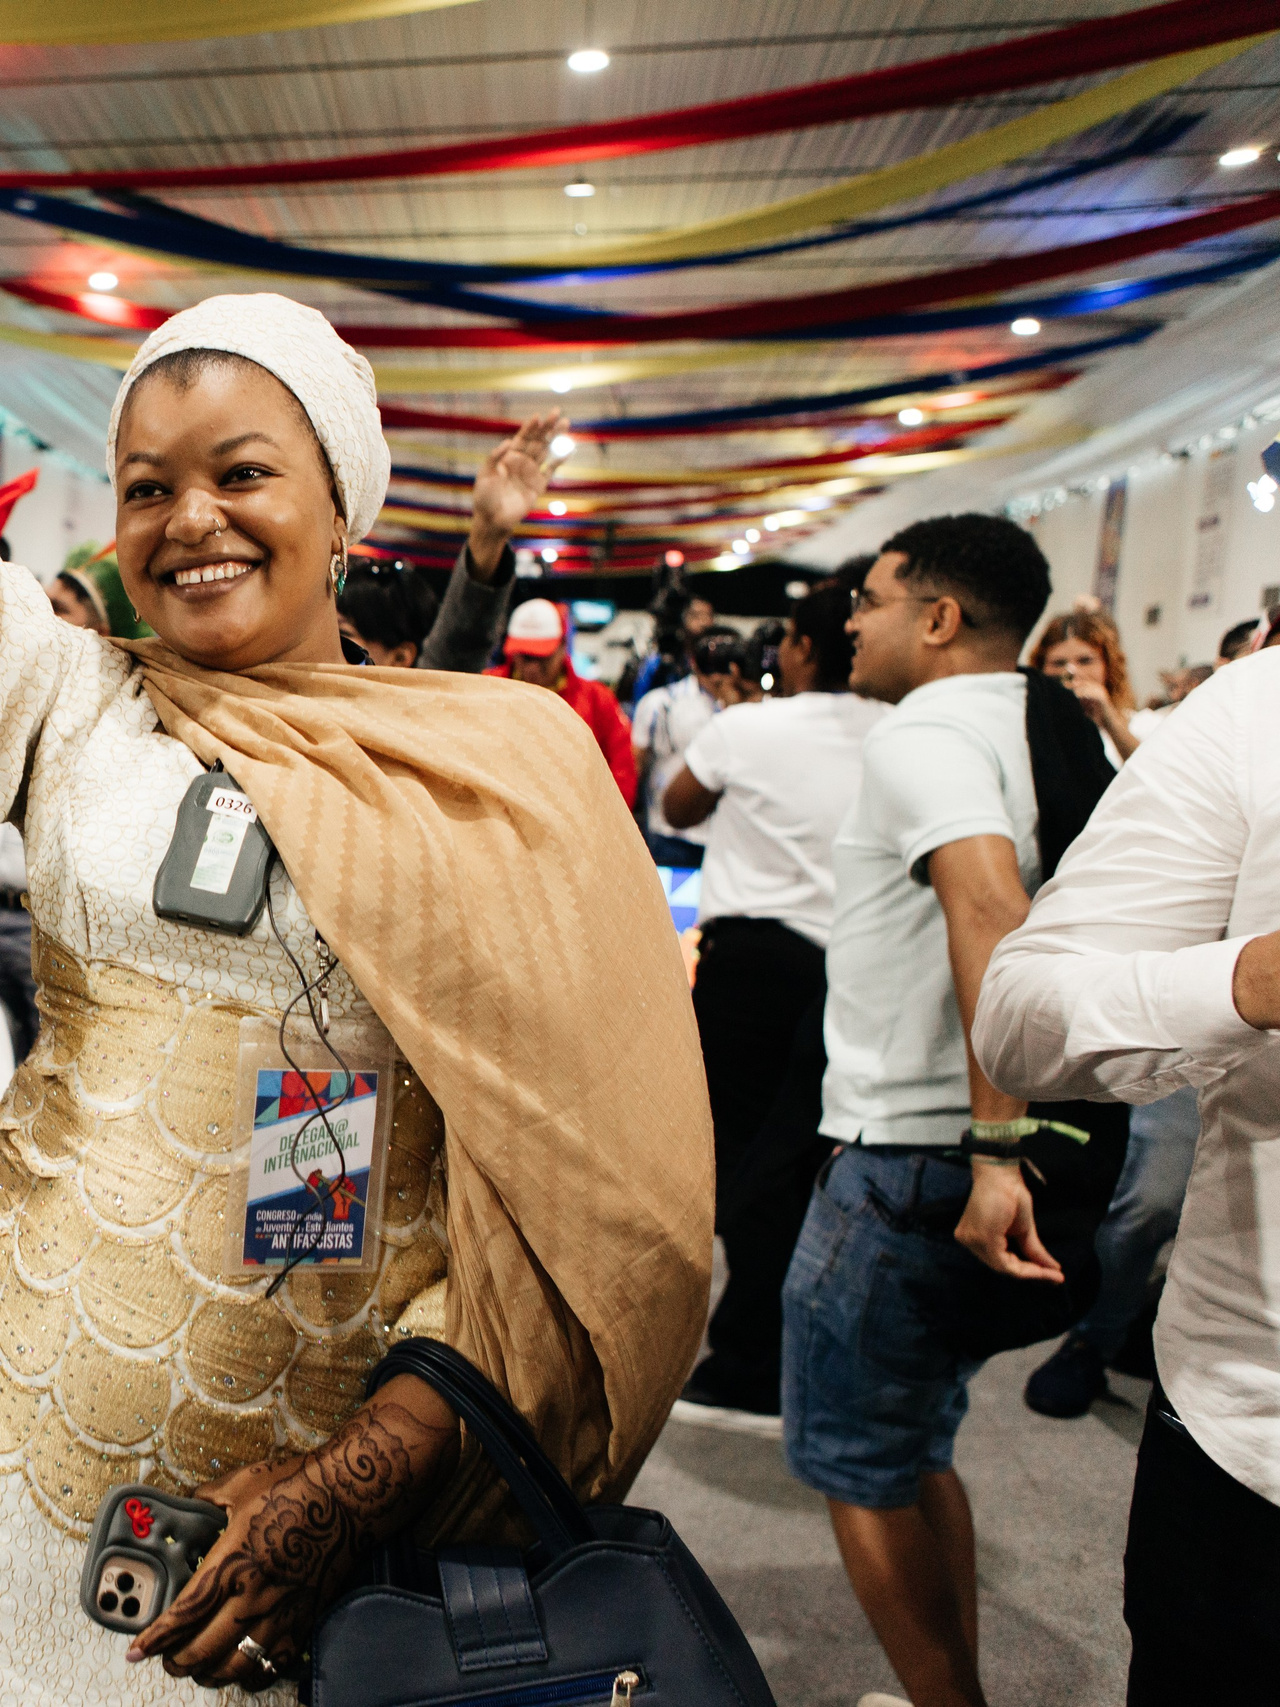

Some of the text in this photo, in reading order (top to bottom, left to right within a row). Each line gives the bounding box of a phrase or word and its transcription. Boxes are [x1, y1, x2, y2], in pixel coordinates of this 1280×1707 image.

[215, 796, 253, 814] 0326
[264, 1132, 360, 1174] INTERNACIONAL
[256, 1210, 296, 1221] CONGRESO
